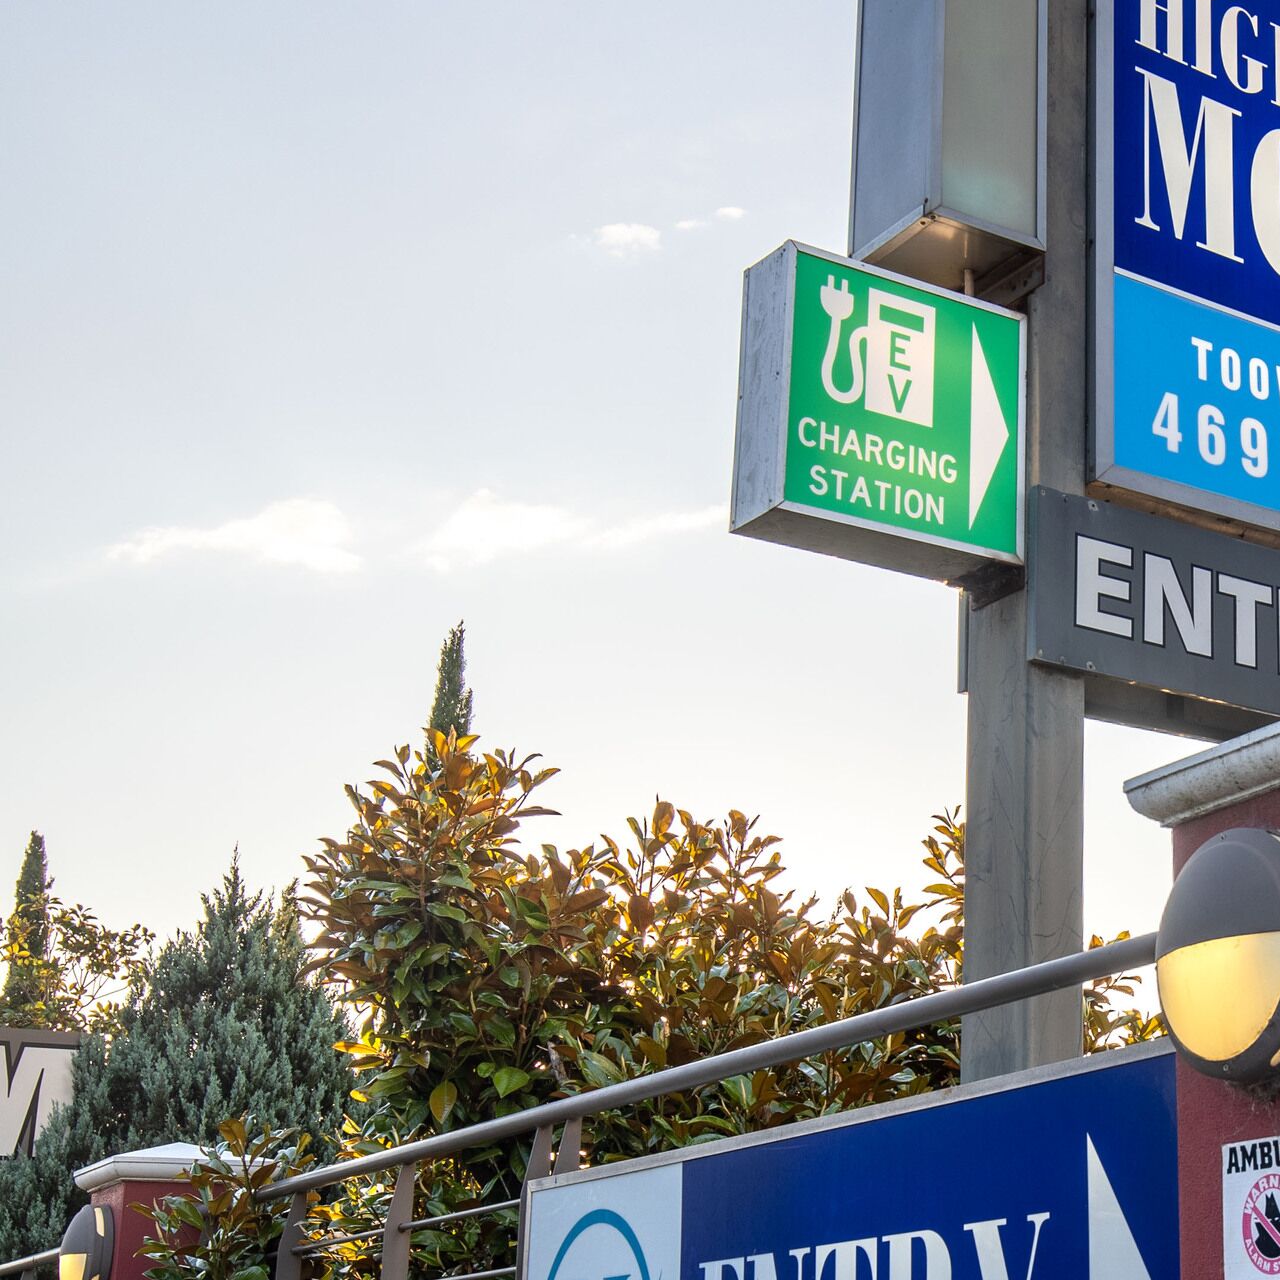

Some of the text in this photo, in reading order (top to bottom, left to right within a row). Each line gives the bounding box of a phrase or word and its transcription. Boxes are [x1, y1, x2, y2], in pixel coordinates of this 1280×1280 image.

[798, 416, 957, 484] CHARGING
[809, 465, 944, 525] STATION
[1245, 1238, 1272, 1272] ALARM
